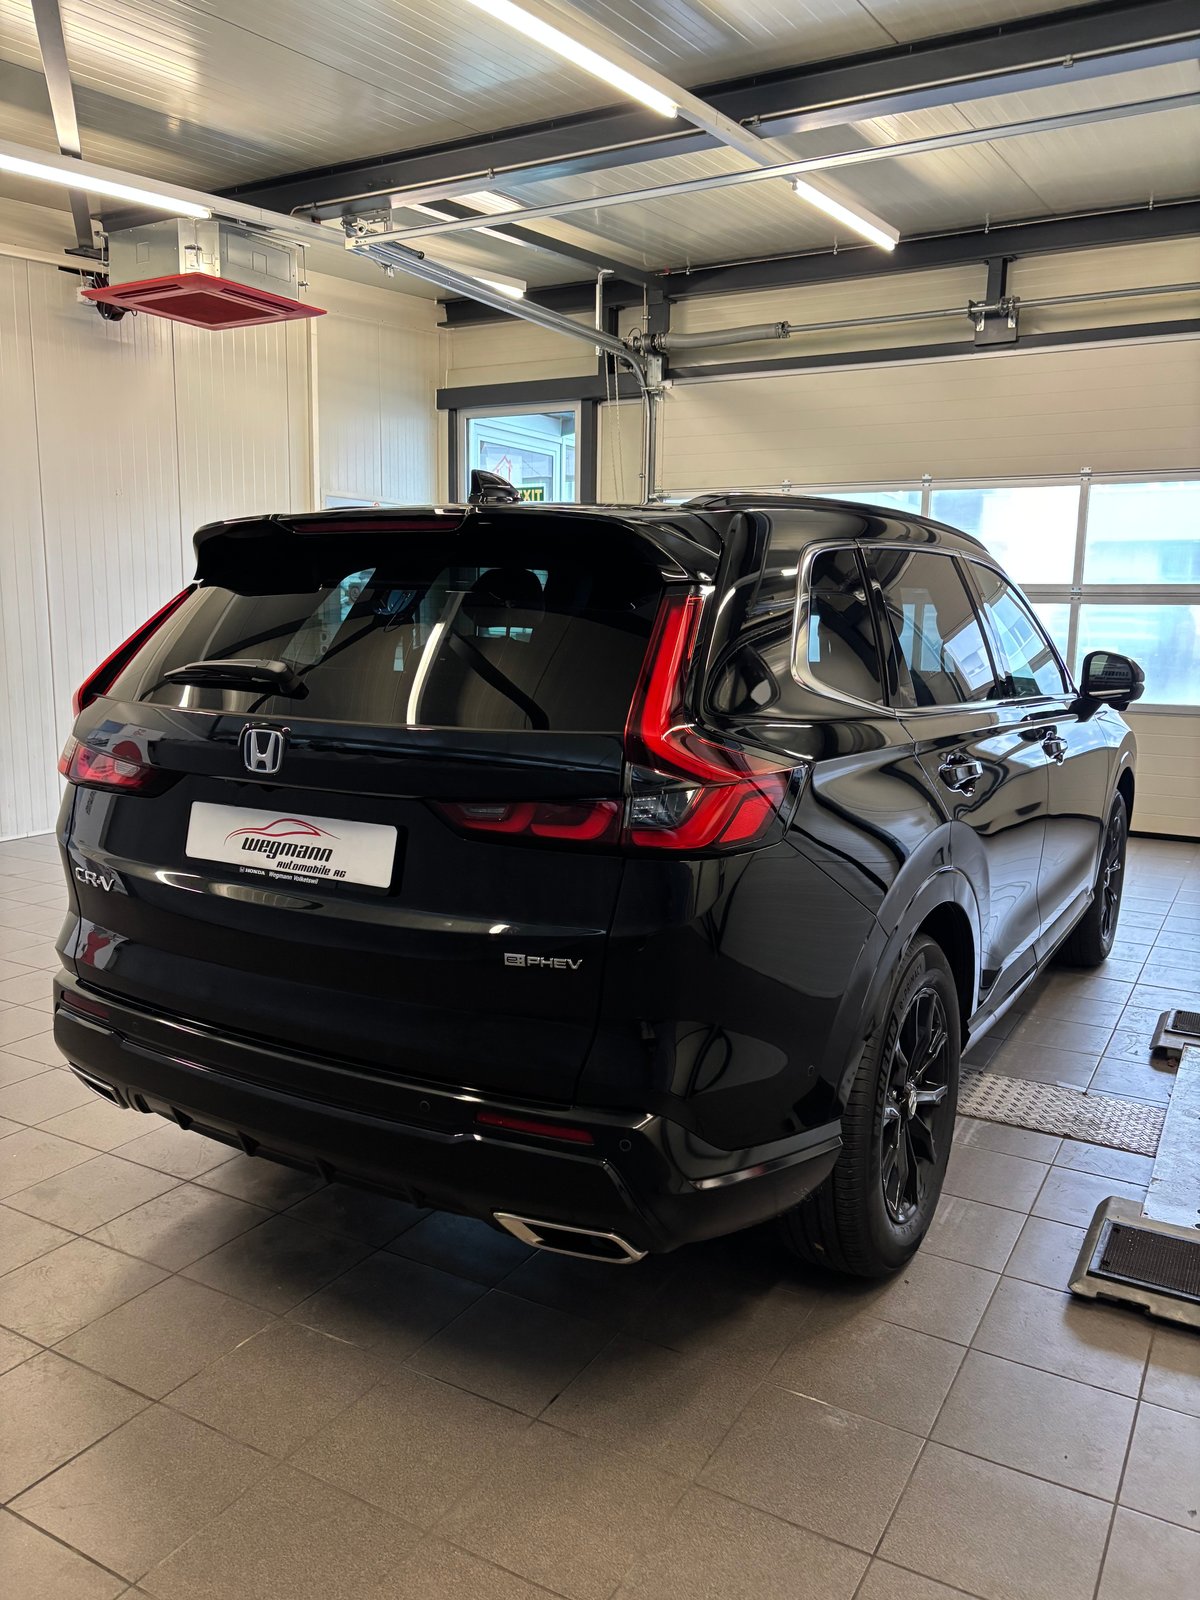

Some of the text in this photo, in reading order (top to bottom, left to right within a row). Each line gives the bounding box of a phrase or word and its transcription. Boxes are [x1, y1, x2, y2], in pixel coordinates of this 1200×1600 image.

[75, 867, 115, 892] CR-V
[245, 868, 265, 876] HONDA
[268, 872, 293, 880] Wegmann
[333, 869, 347, 879] AG
[873, 1018, 898, 1137] MICHELIN
